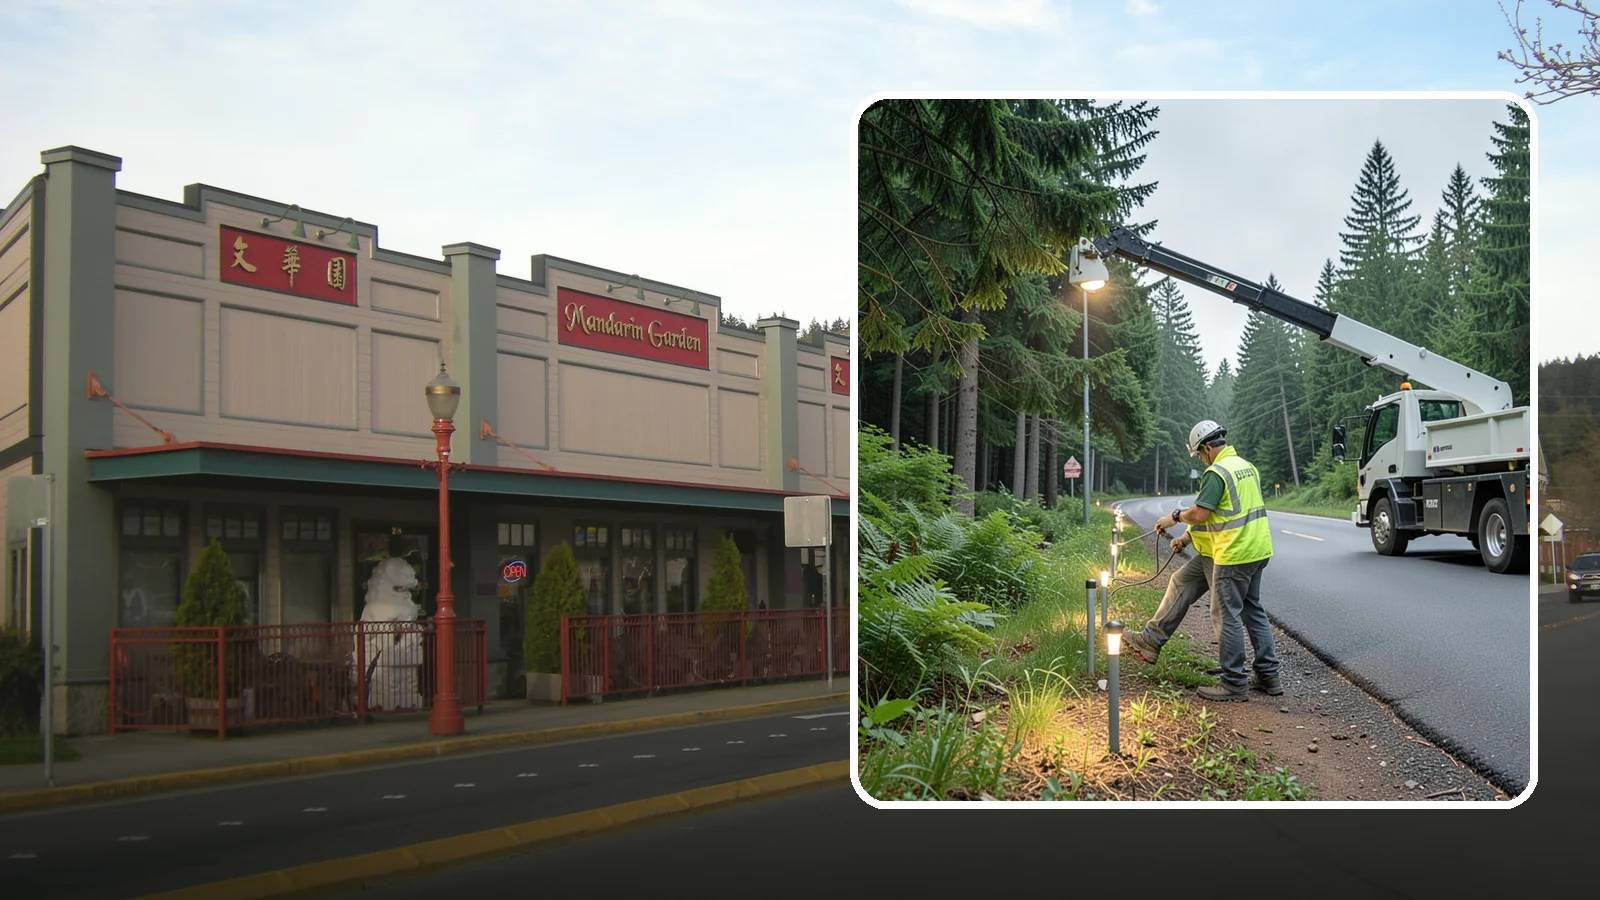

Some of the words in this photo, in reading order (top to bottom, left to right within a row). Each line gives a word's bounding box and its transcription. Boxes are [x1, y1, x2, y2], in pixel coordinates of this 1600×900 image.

[231, 235, 346, 290] 文華園
[564, 302, 644, 341] Mandarin
[648, 320, 701, 352] Garden
[503, 565, 527, 578] OPEN
